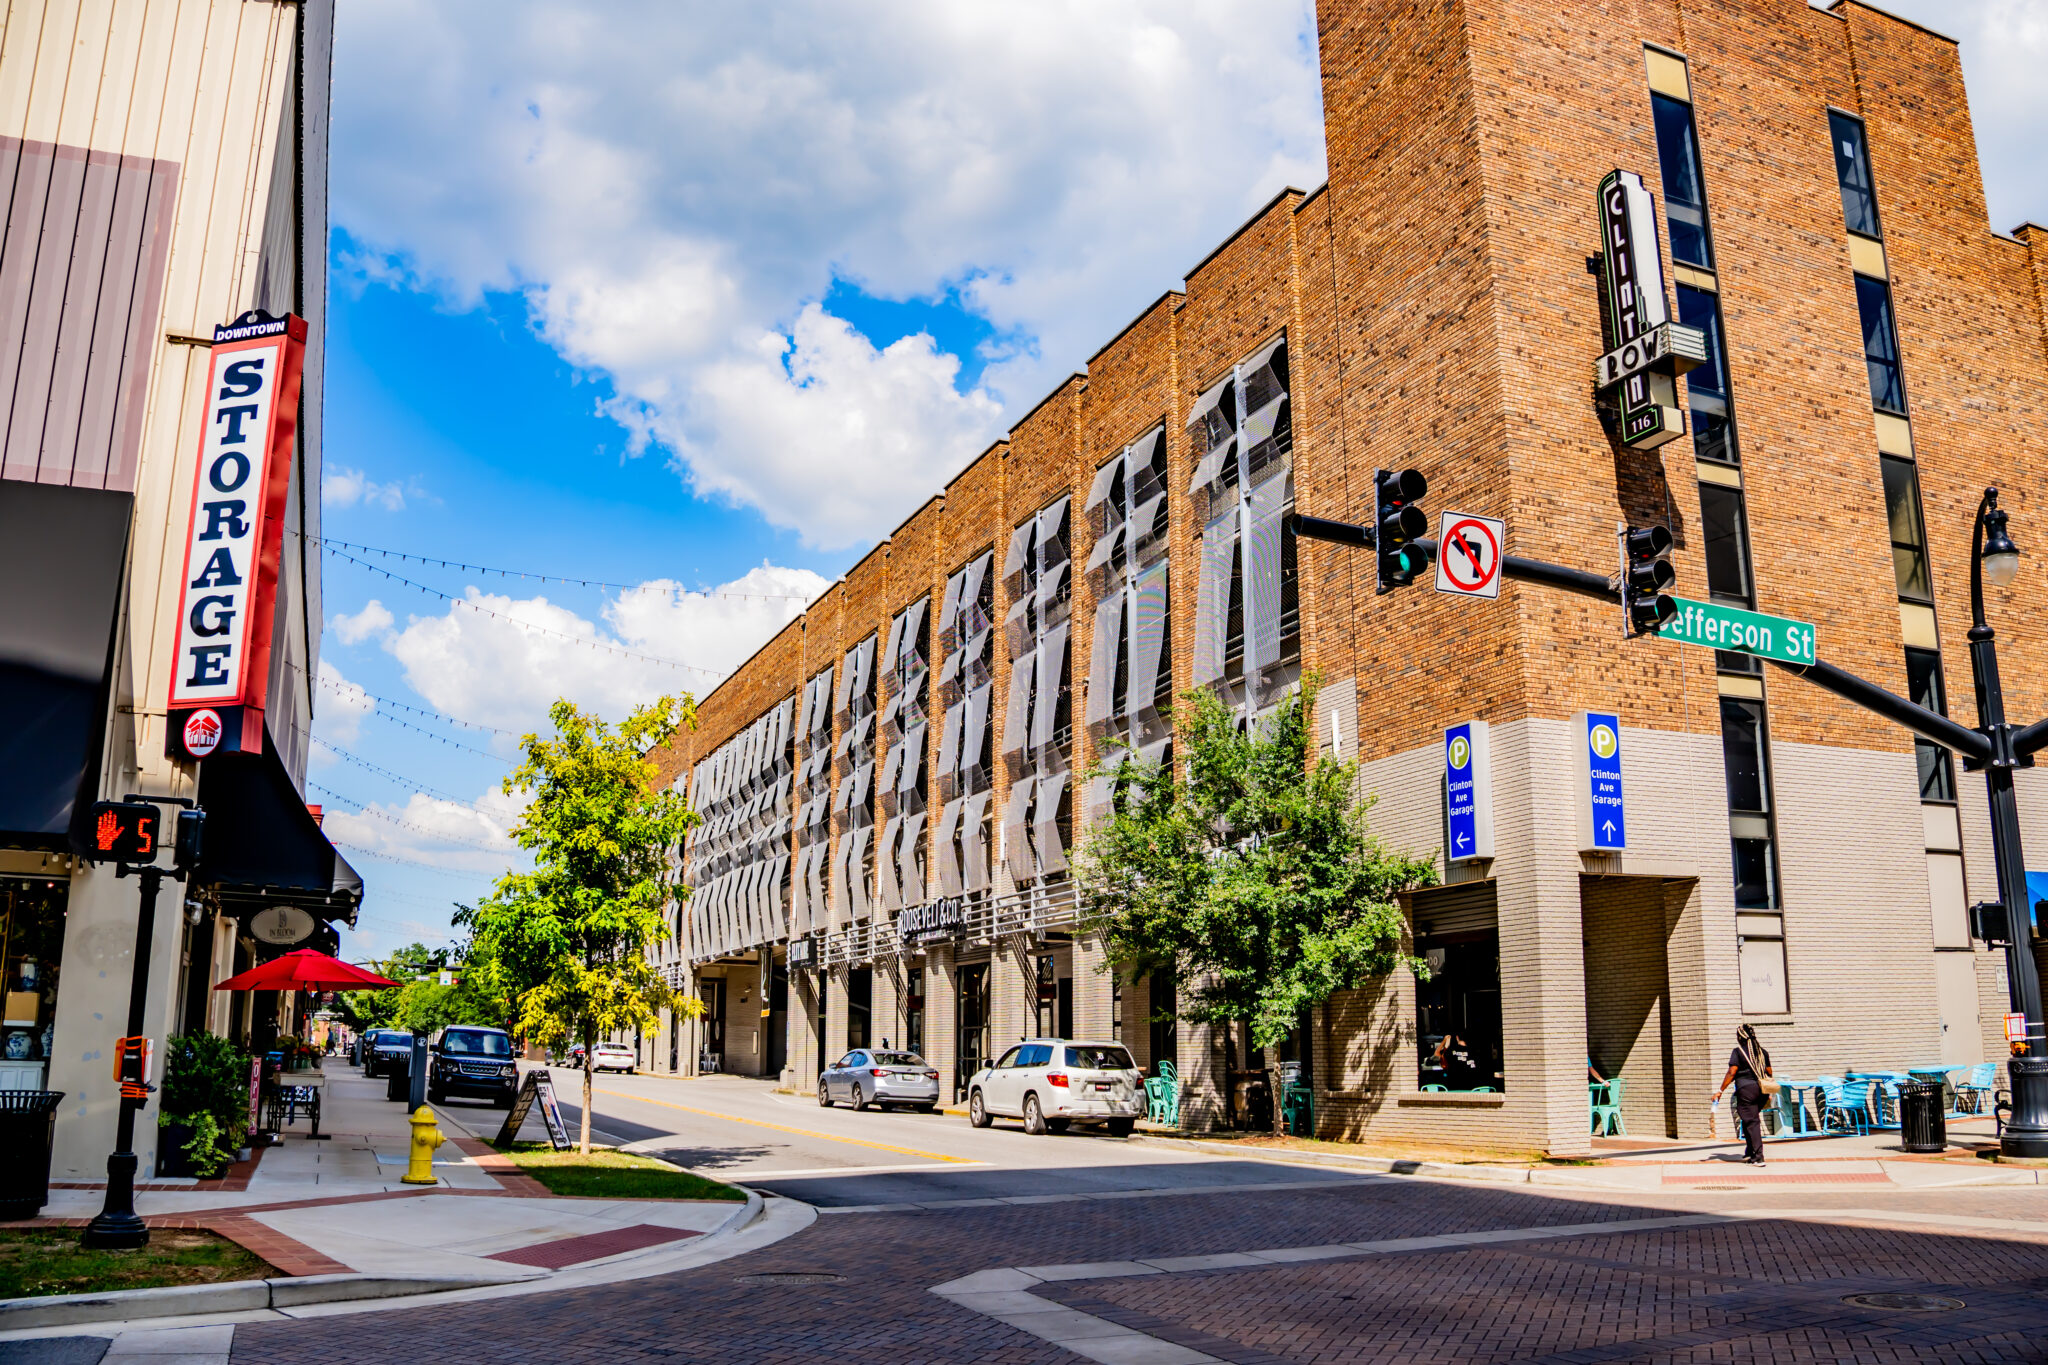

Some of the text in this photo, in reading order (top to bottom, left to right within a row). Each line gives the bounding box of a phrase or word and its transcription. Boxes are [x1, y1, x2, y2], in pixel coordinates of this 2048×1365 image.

[216, 321, 286, 341] DOWNTOWN
[1606, 330, 1660, 381] ROW
[1631, 414, 1652, 434] 116
[185, 358, 264, 688] STORAGE
[1659, 606, 1812, 659] efferson St
[1597, 730, 1610, 753] P
[1454, 741, 1466, 766] P
[1591, 769, 1621, 781] Clinton
[1449, 779, 1473, 792] Clinton
[1599, 782, 1615, 793] Ave
[1455, 793, 1468, 803] Ave
[1592, 795, 1622, 806] Garage
[1450, 804, 1474, 816] Garage
[137, 817, 152, 853] 5
